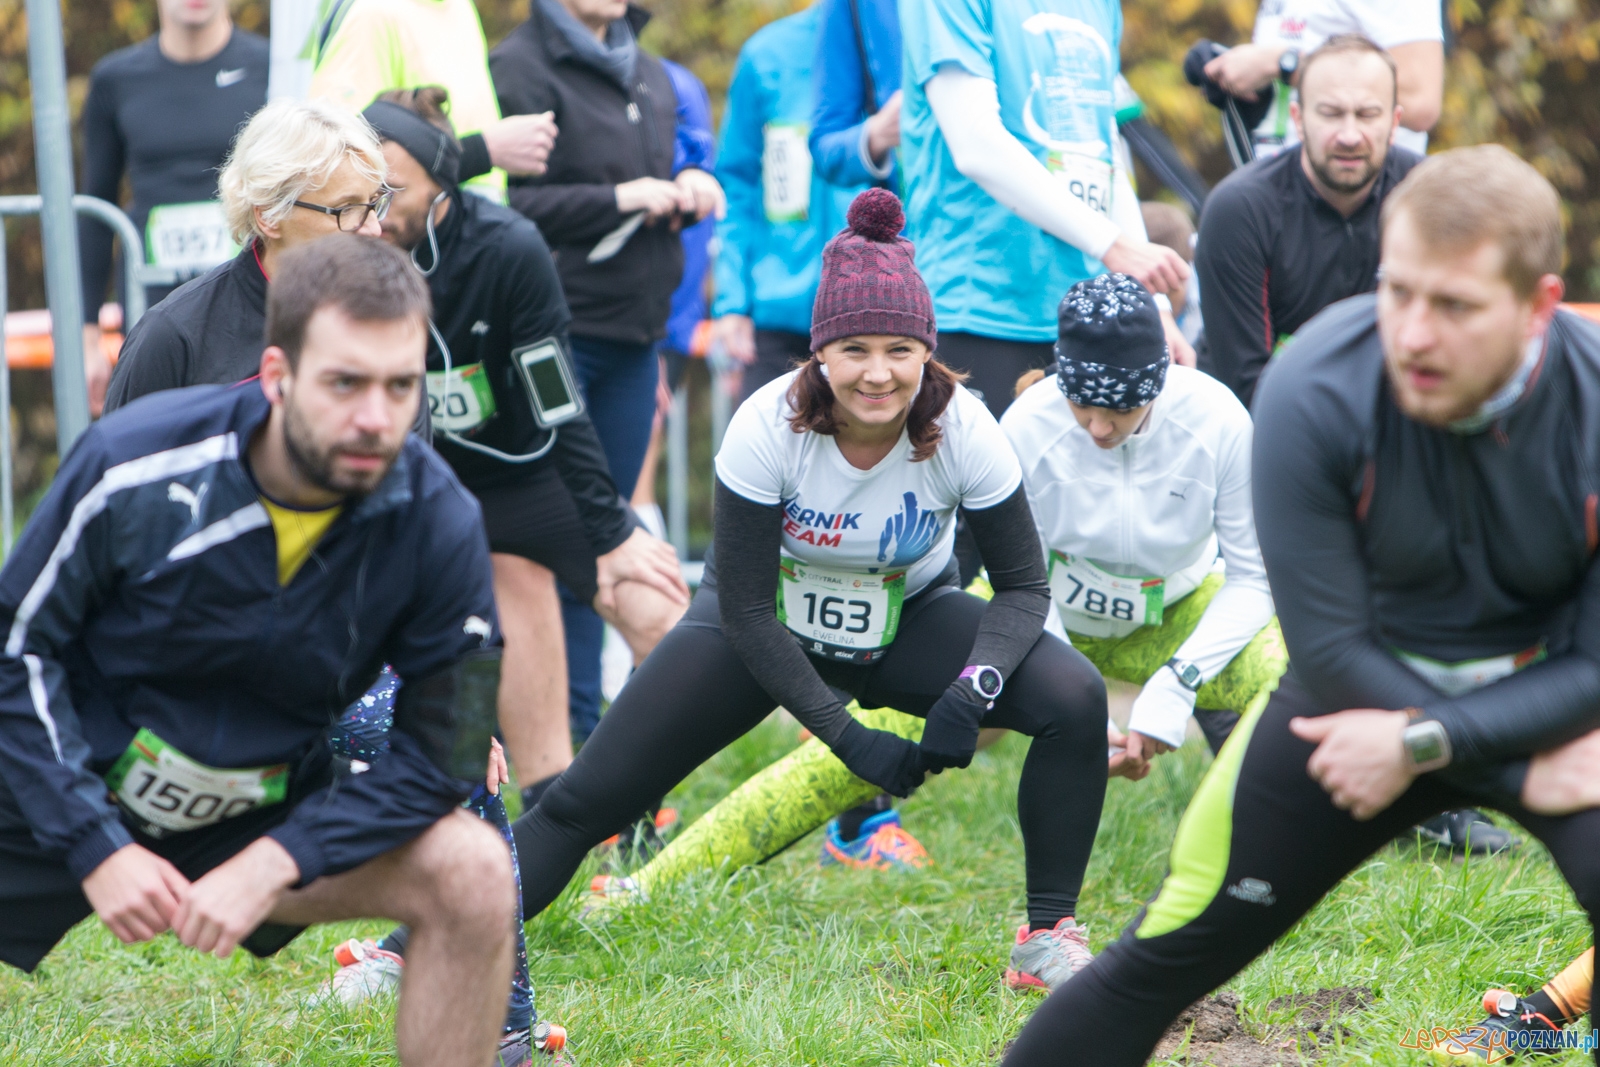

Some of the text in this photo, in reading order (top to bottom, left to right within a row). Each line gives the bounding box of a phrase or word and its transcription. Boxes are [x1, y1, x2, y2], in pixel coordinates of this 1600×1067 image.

[784, 499, 863, 530] ERNIK
[803, 592, 872, 634] 163
[1065, 573, 1135, 622] 788
[813, 629, 856, 647] EWELINA
